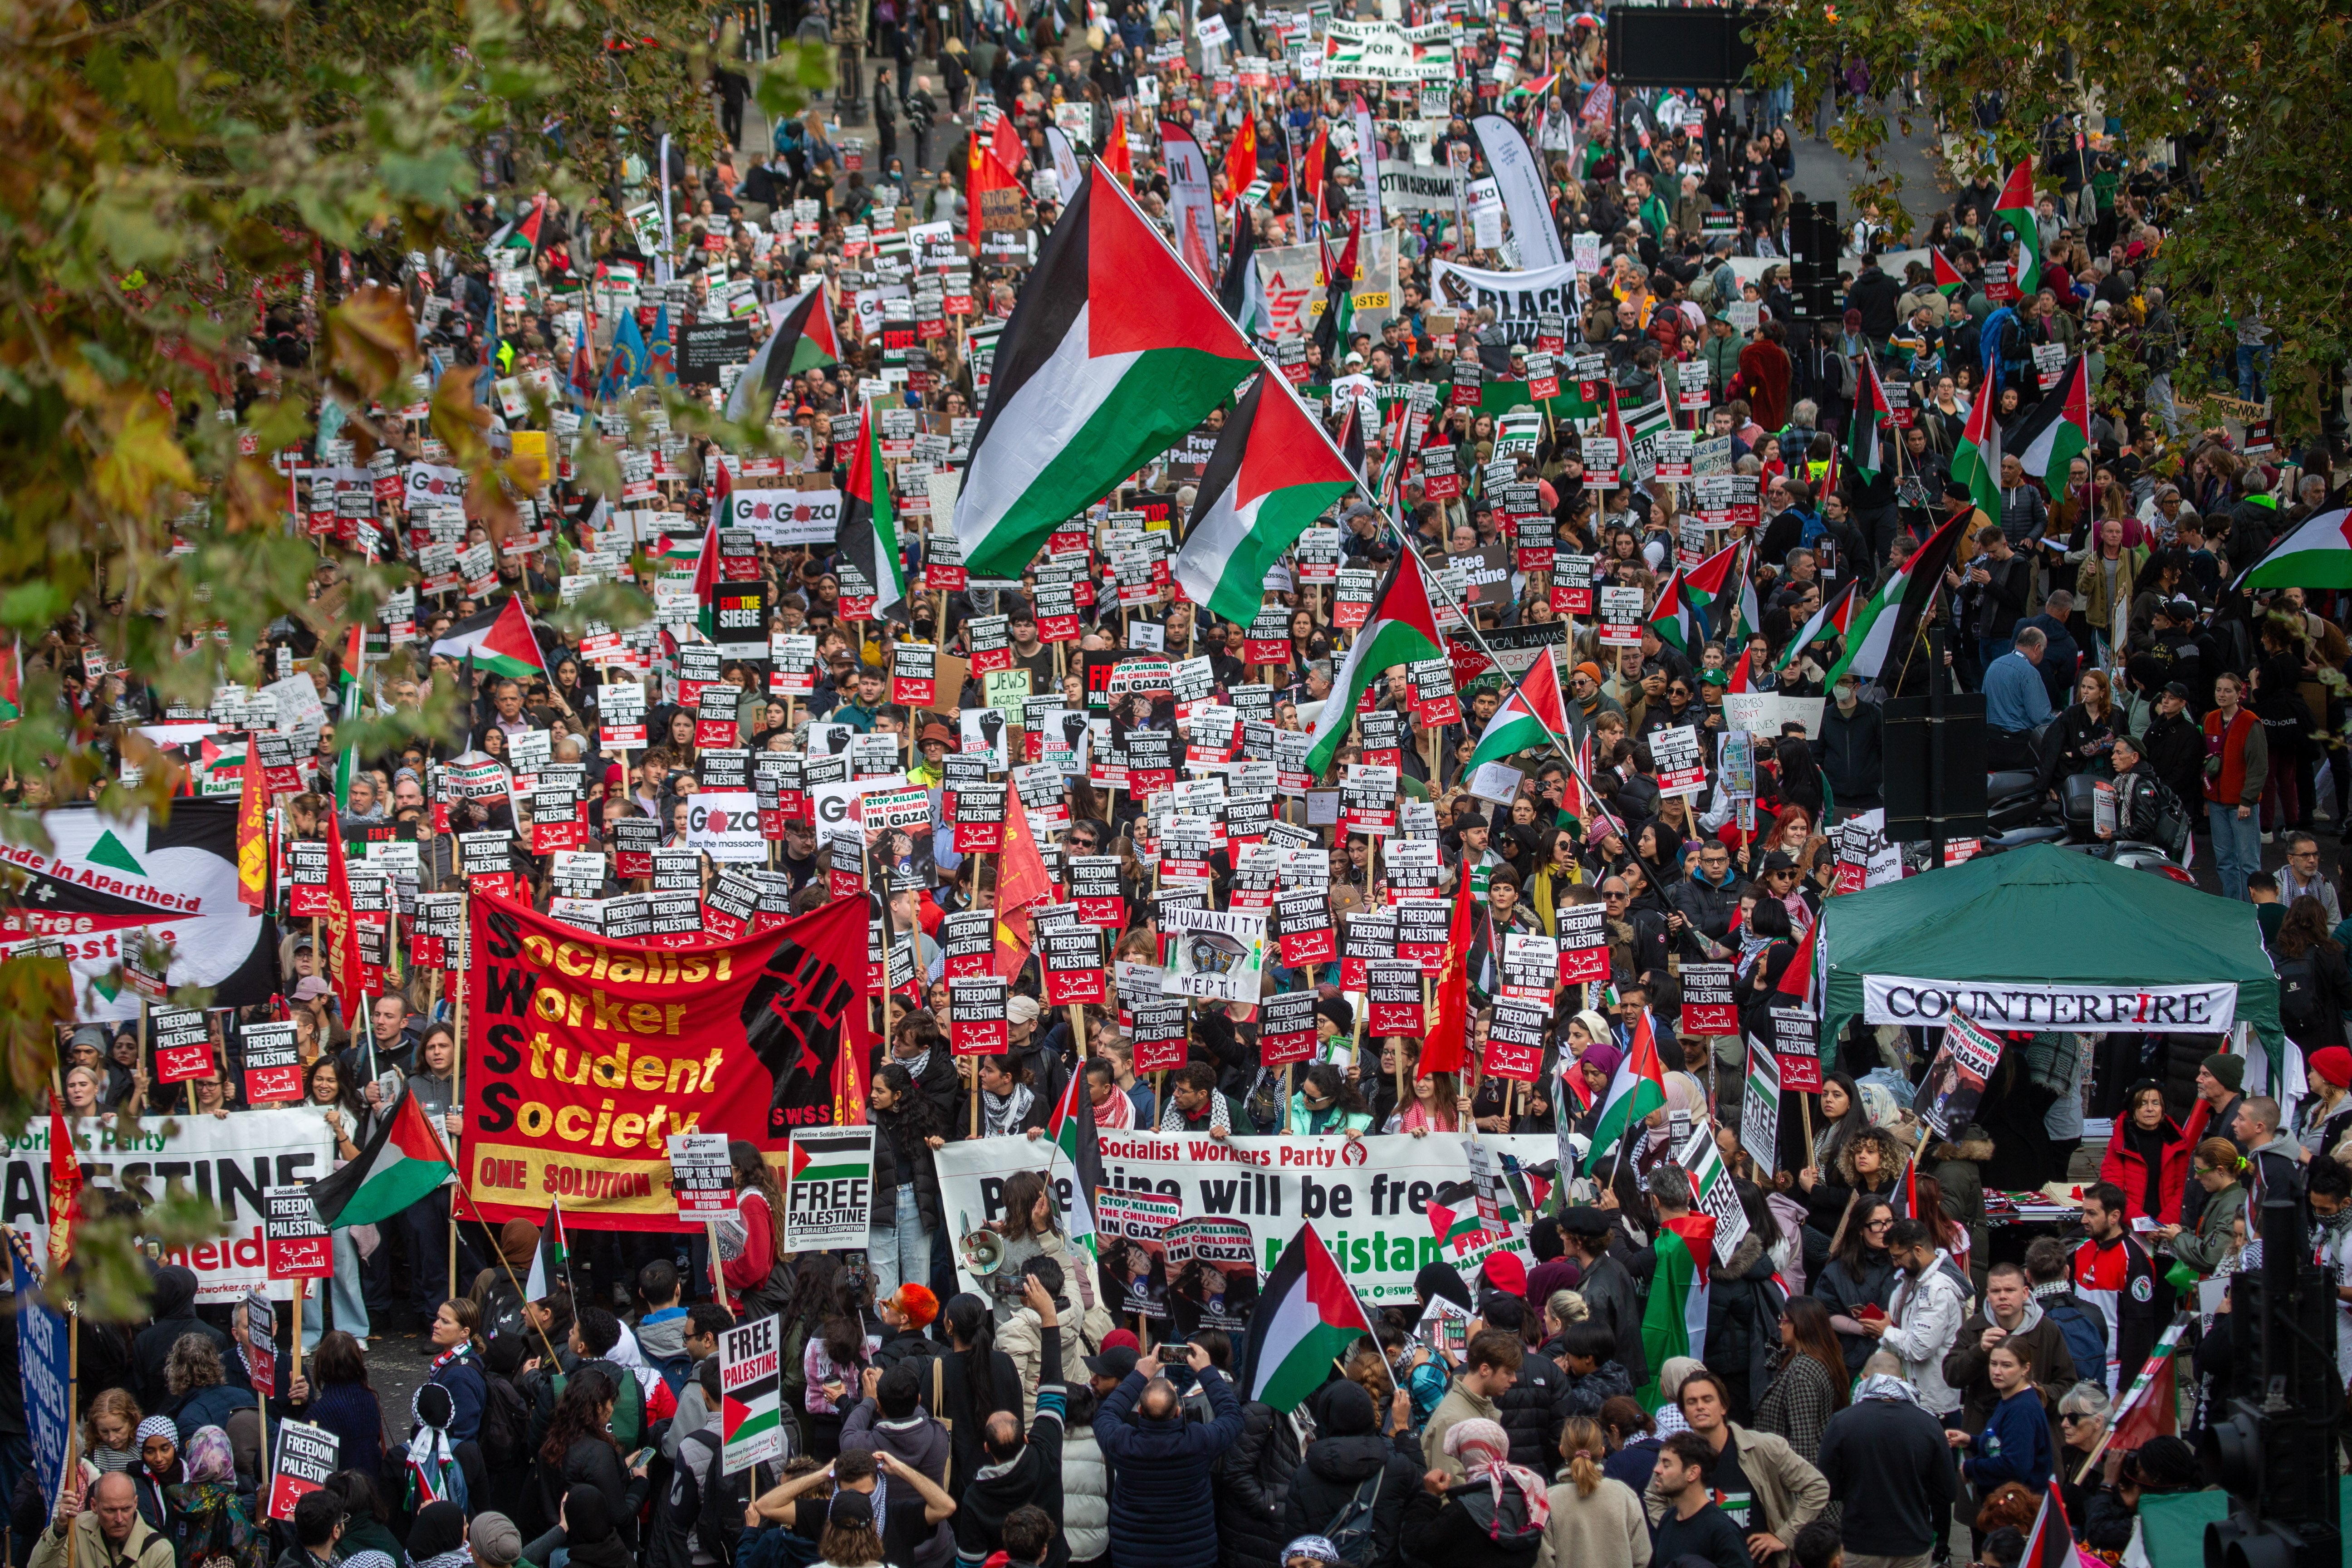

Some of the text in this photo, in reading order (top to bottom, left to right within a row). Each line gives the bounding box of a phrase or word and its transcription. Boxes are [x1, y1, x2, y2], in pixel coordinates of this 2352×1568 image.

[1329, 20, 1450, 40] HEALTH WORKERS
[1365, 44, 1409, 56] FOR A
[1327, 64, 1447, 78] FREE PALESTINE
[1422, 92, 1448, 102] FREE
[1409, 176, 1423, 195] OUR
[981, 188, 1009, 203] STOP
[981, 204, 1019, 216] BOMBING
[986, 216, 1017, 230] GAZA
[992, 232, 1016, 244] Free
[981, 242, 1027, 255] Palestine
[687, 327, 726, 341] genocide
[1691, 438, 1729, 458] JEWS UNITED
[1691, 459, 1711, 472] AGAINST
[1712, 457, 1719, 468] 75
[804, 525, 837, 534] massacre
[1449, 554, 1484, 572] Free
[1556, 563, 1591, 575] FREEDOM
[1554, 576, 1591, 588] PALESTINE
[720, 596, 761, 610] END THE
[720, 609, 760, 628] SIEGE
[1524, 630, 1566, 644] HAMAS
[897, 651, 935, 664] FREEDOM
[1453, 654, 1523, 669] WORKS FOR
[895, 664, 934, 678] PALESTINE
[990, 671, 1025, 691] JEWS
[1732, 697, 1764, 709] BOMBS
[1781, 701, 1818, 711] JOE BIDEN
[1733, 709, 1759, 720] DON'T
[1044, 741, 1068, 751] EXIST.
[1044, 751, 1073, 761] RESIST.
[865, 791, 926, 807] STOP KILLING
[864, 801, 928, 815] THE CHILDREN
[867, 809, 928, 828] IN GAZA
[705, 839, 715, 848] the
[27, 912, 93, 934] Free
[1167, 908, 1263, 936] HUMANITY
[487, 912, 736, 985] Socialist
[1684, 975, 1729, 986] FREEDOM
[955, 986, 1000, 1001] FREEDOM
[1181, 976, 1237, 1000] WEPT!
[485, 966, 686, 1036] Worker
[1683, 990, 1733, 1004] PALESTINE
[1887, 986, 2211, 1025] COUNTERFIRE
[953, 1008, 1005, 1021] PALESTINE
[1693, 1007, 1725, 1019] الحرية
[962, 1024, 996, 1036] الحرية
[1690, 1019, 1731, 1030] لفلسطين
[247, 1033, 292, 1046] FREEDOM
[1950, 1014, 1999, 1054] STOP KILLING
[958, 1035, 1001, 1049] لفلسطين
[1949, 1024, 1996, 1065] THE CHILDREN
[246, 1052, 297, 1067] PALESTINE
[483, 1024, 723, 1095] Student
[1947, 1036, 1989, 1078] IN GAZA
[255, 1070, 290, 1083] الحرية
[255, 1082, 295, 1097] لفلسطين
[478, 1082, 701, 1158] Society
[772, 1104, 831, 1126] SWSS
[819, 1130, 845, 1138] Solidarity
[1099, 1137, 1336, 1168] Socialist Workers Party
[480, 1158, 651, 1199] ONE SOLUTION
[674, 1167, 731, 1178] STOP THE WAR
[686, 1178, 722, 1189] ON GAZA!
[681, 1190, 730, 1200] FOR A SOCIALIST
[790, 1179, 868, 1211] FREE
[1200, 1171, 1280, 1217] will
[1301, 1175, 1352, 1219] be
[695, 1200, 722, 1210] INTIFADA
[788, 1209, 867, 1225] PALESTINE
[831, 1224, 865, 1232] OCCUPATION
[800, 1235, 853, 1244] www.palestinecampaign.org
[25, 1298, 54, 1363] WEST
[727, 1319, 771, 1360] FREE
[723, 1350, 777, 1388] PALESTINE
[23, 1338, 67, 1422] SUSSEX
[725, 1450, 743, 1460] Palestine
[758, 1438, 770, 1448] Britain
